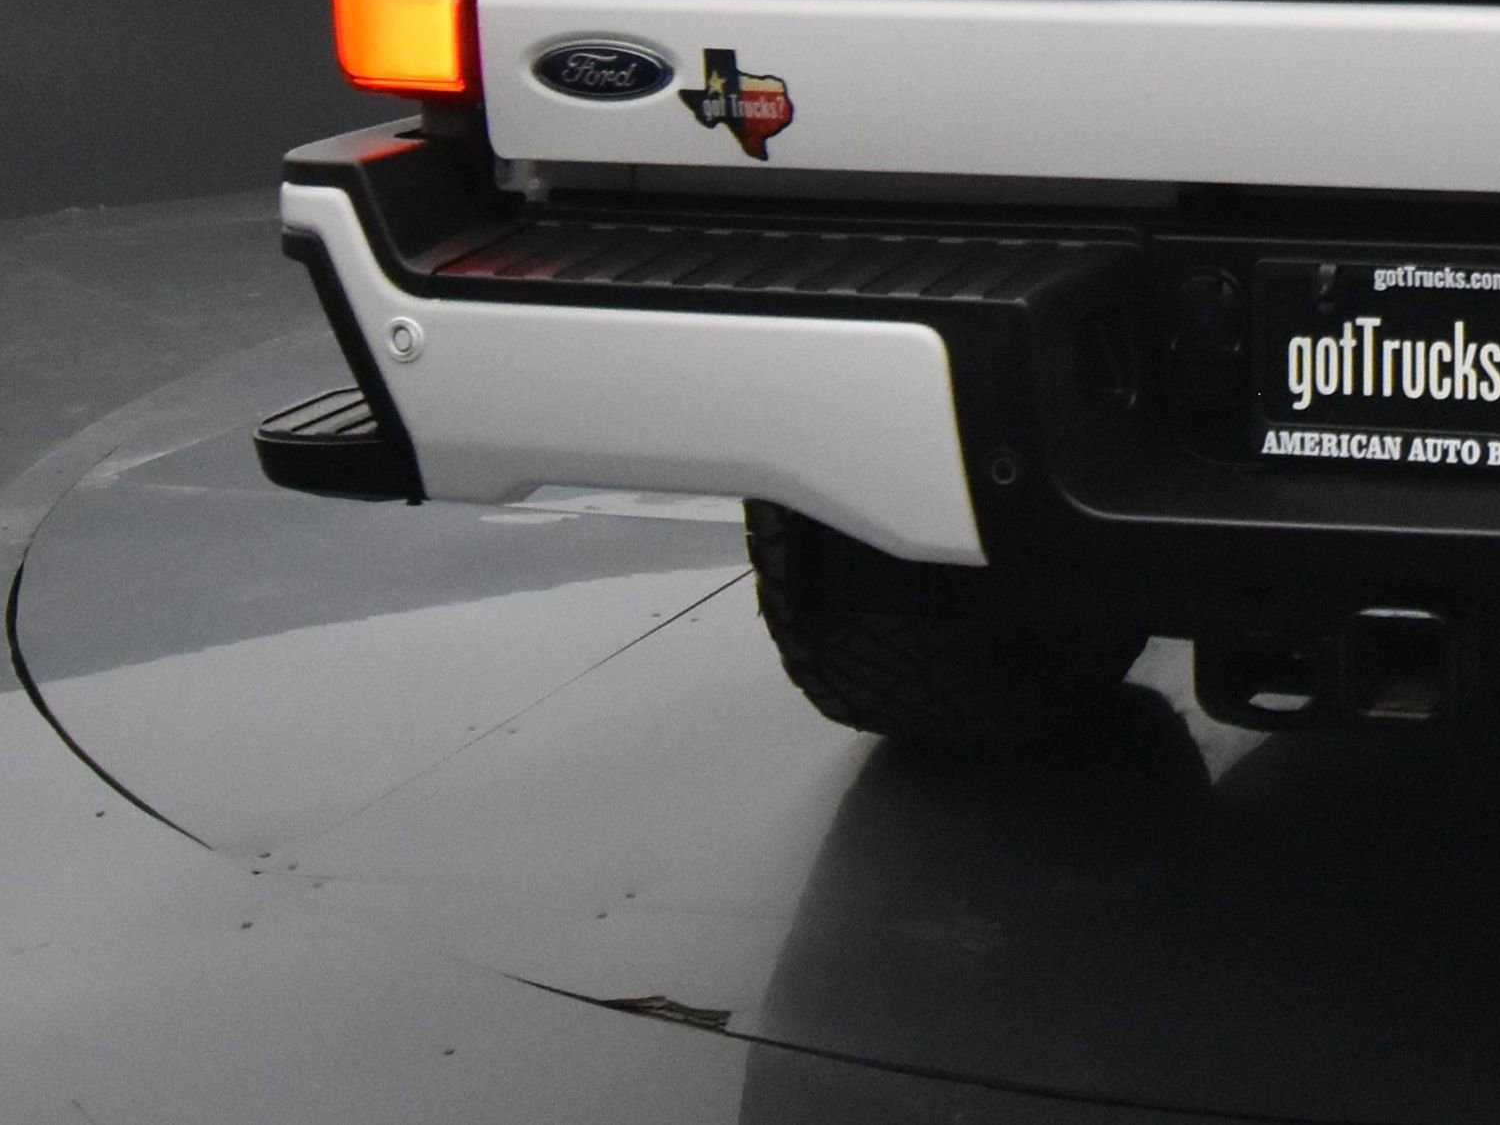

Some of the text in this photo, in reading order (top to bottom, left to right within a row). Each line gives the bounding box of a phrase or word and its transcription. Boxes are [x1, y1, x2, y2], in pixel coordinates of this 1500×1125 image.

[561, 52, 637, 88] Ford
[703, 93, 785, 121] got Trucks?
[1262, 430, 1401, 460] AMERICAN
[1408, 437, 1480, 465] AUTO
